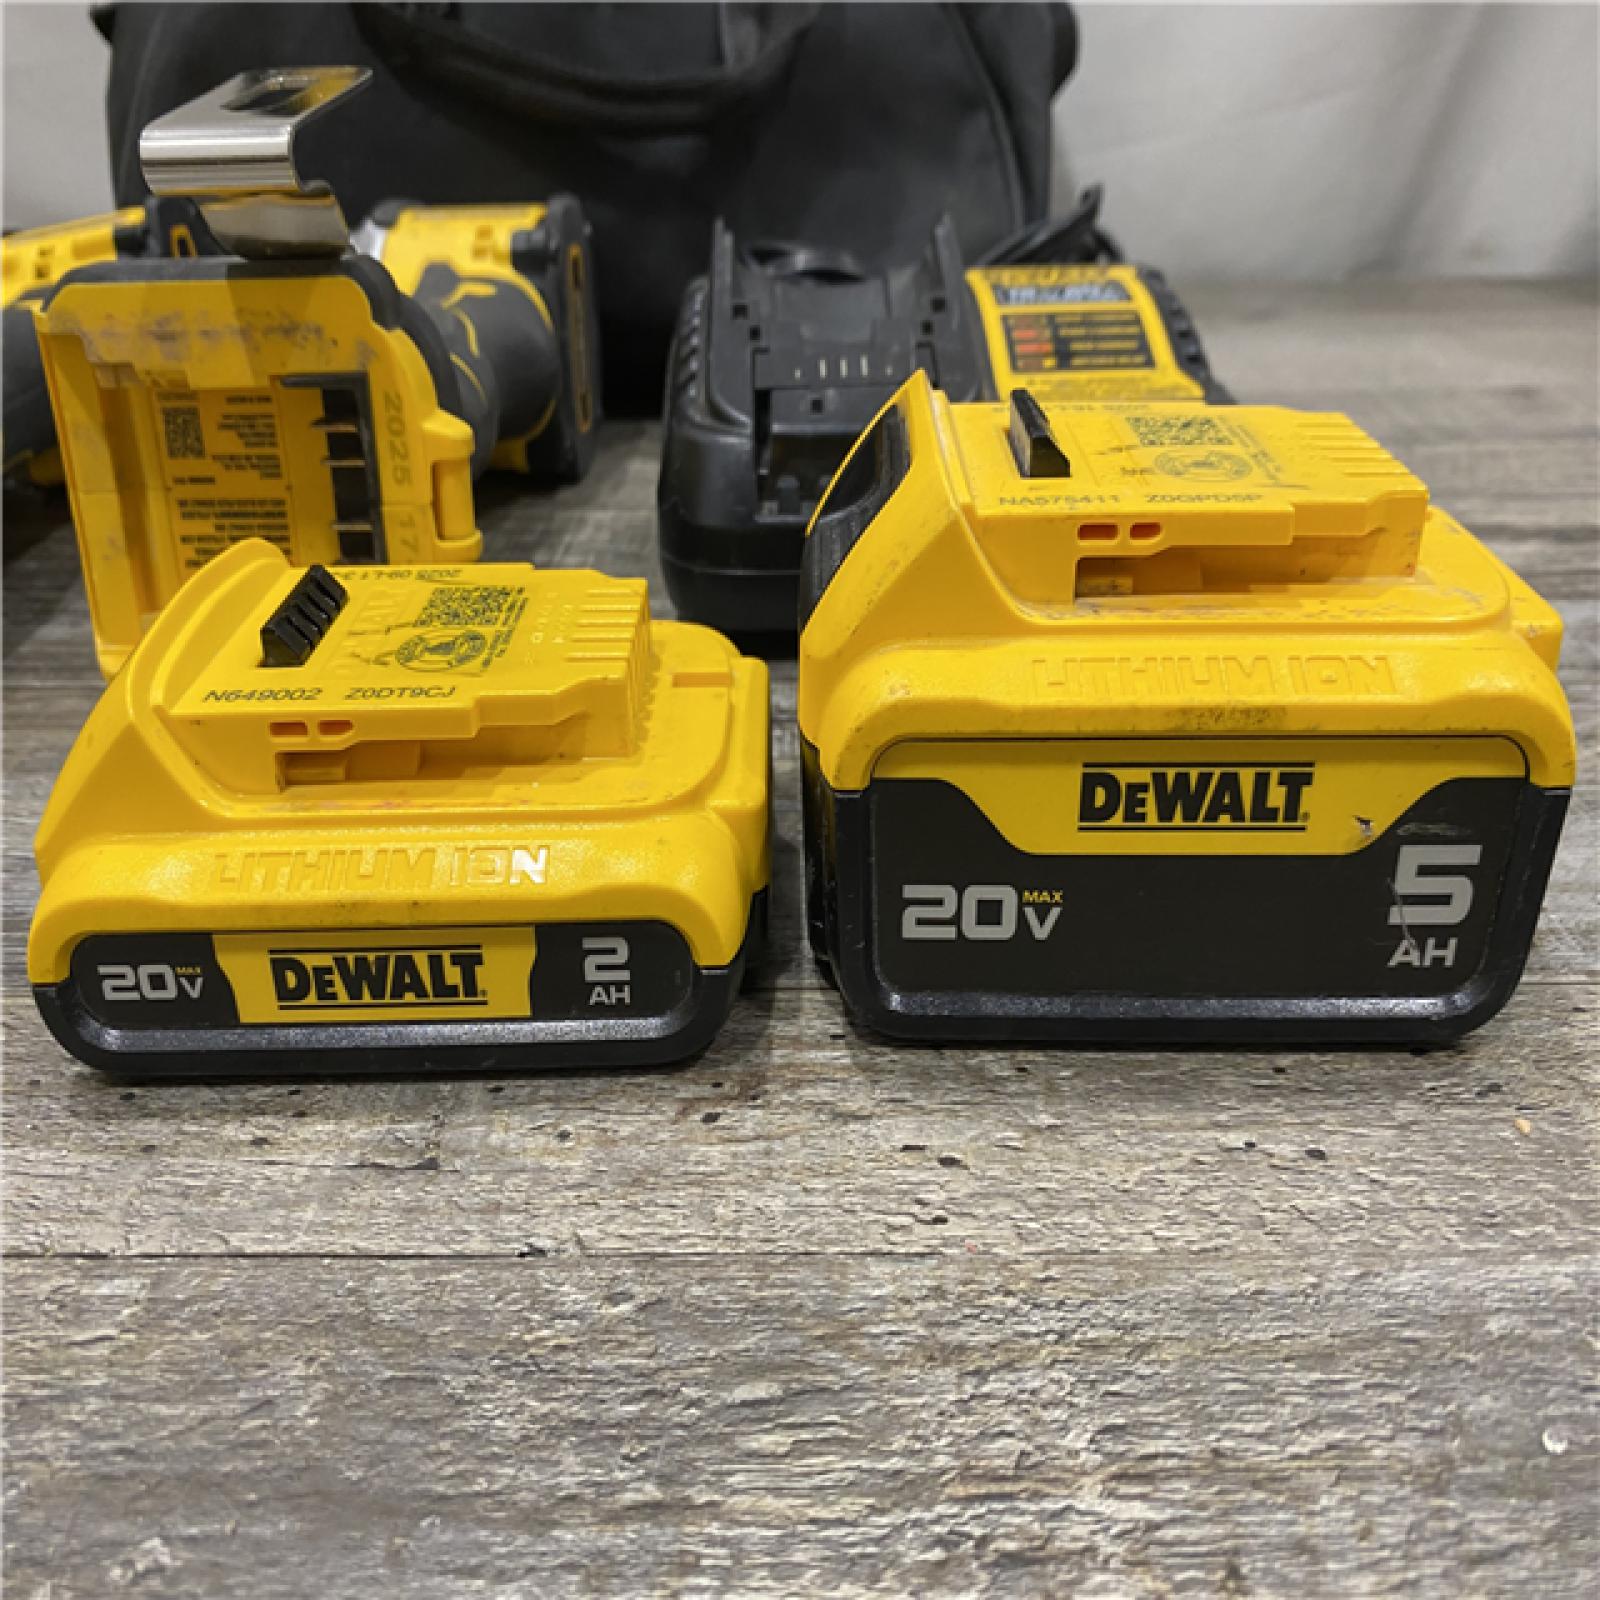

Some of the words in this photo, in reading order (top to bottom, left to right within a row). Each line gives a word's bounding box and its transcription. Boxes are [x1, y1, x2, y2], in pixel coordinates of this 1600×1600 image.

[1031, 655, 1264, 697] LITHIUM
[1286, 654, 1396, 694] ION
[211, 846, 436, 893] LITHIUM
[450, 845, 549, 886] ION
[1388, 844, 1483, 925] 5
[1022, 889, 1064, 903] MAX
[582, 937, 632, 982] 2
[1387, 936, 1458, 968] AH
[588, 984, 631, 1007] AH
